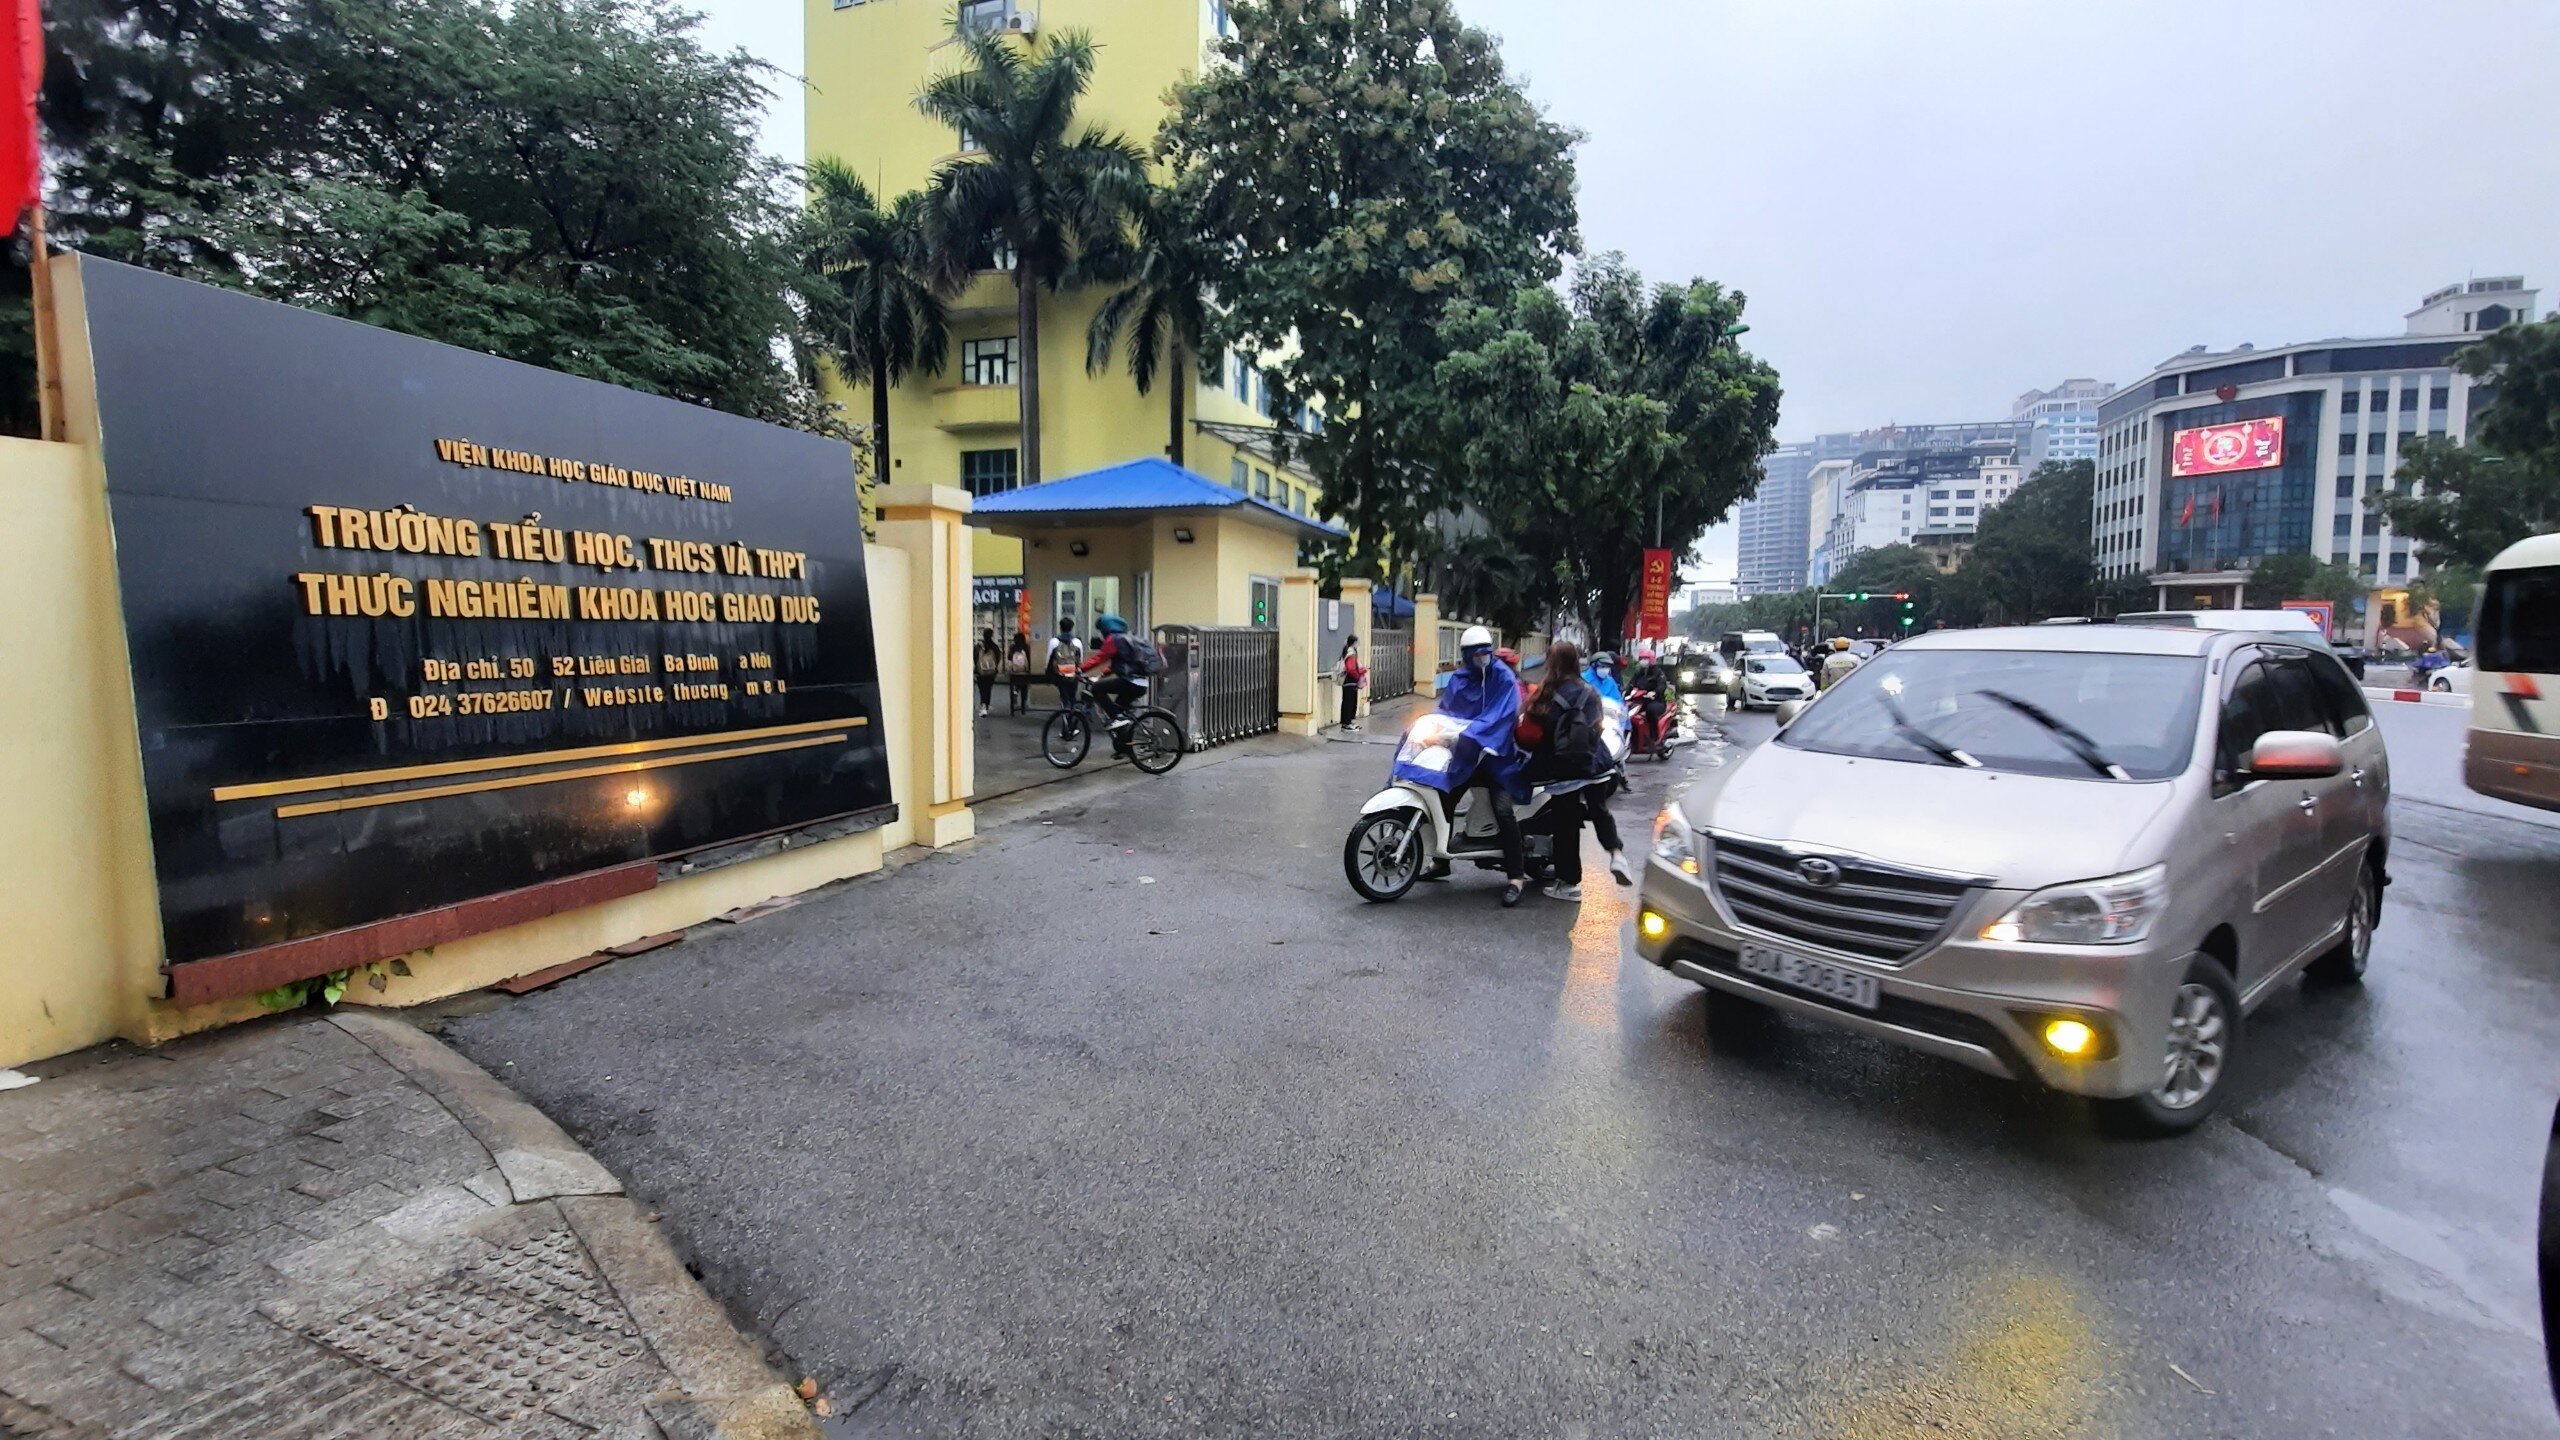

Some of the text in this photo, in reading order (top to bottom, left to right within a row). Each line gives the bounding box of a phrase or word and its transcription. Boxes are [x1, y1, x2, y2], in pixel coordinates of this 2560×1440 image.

[437, 438, 732, 503] VIỆN KHOA HỌC GIÁO DỤC VIỆT NAM
[311, 503, 807, 580] TRƯỜNG TIỂU HỌC, THCS VÀ THPT
[578, 586, 659, 621] KHOA
[423, 658, 462, 685] Địa
[509, 657, 535, 678] 50
[552, 656, 575, 677] 52
[619, 655, 651, 675] Giai
[663, 653, 684, 673] Ba
[408, 694, 452, 719] 024
[457, 689, 553, 715] 37626607
[563, 688, 572, 709] /
[583, 685, 664, 707] Website
